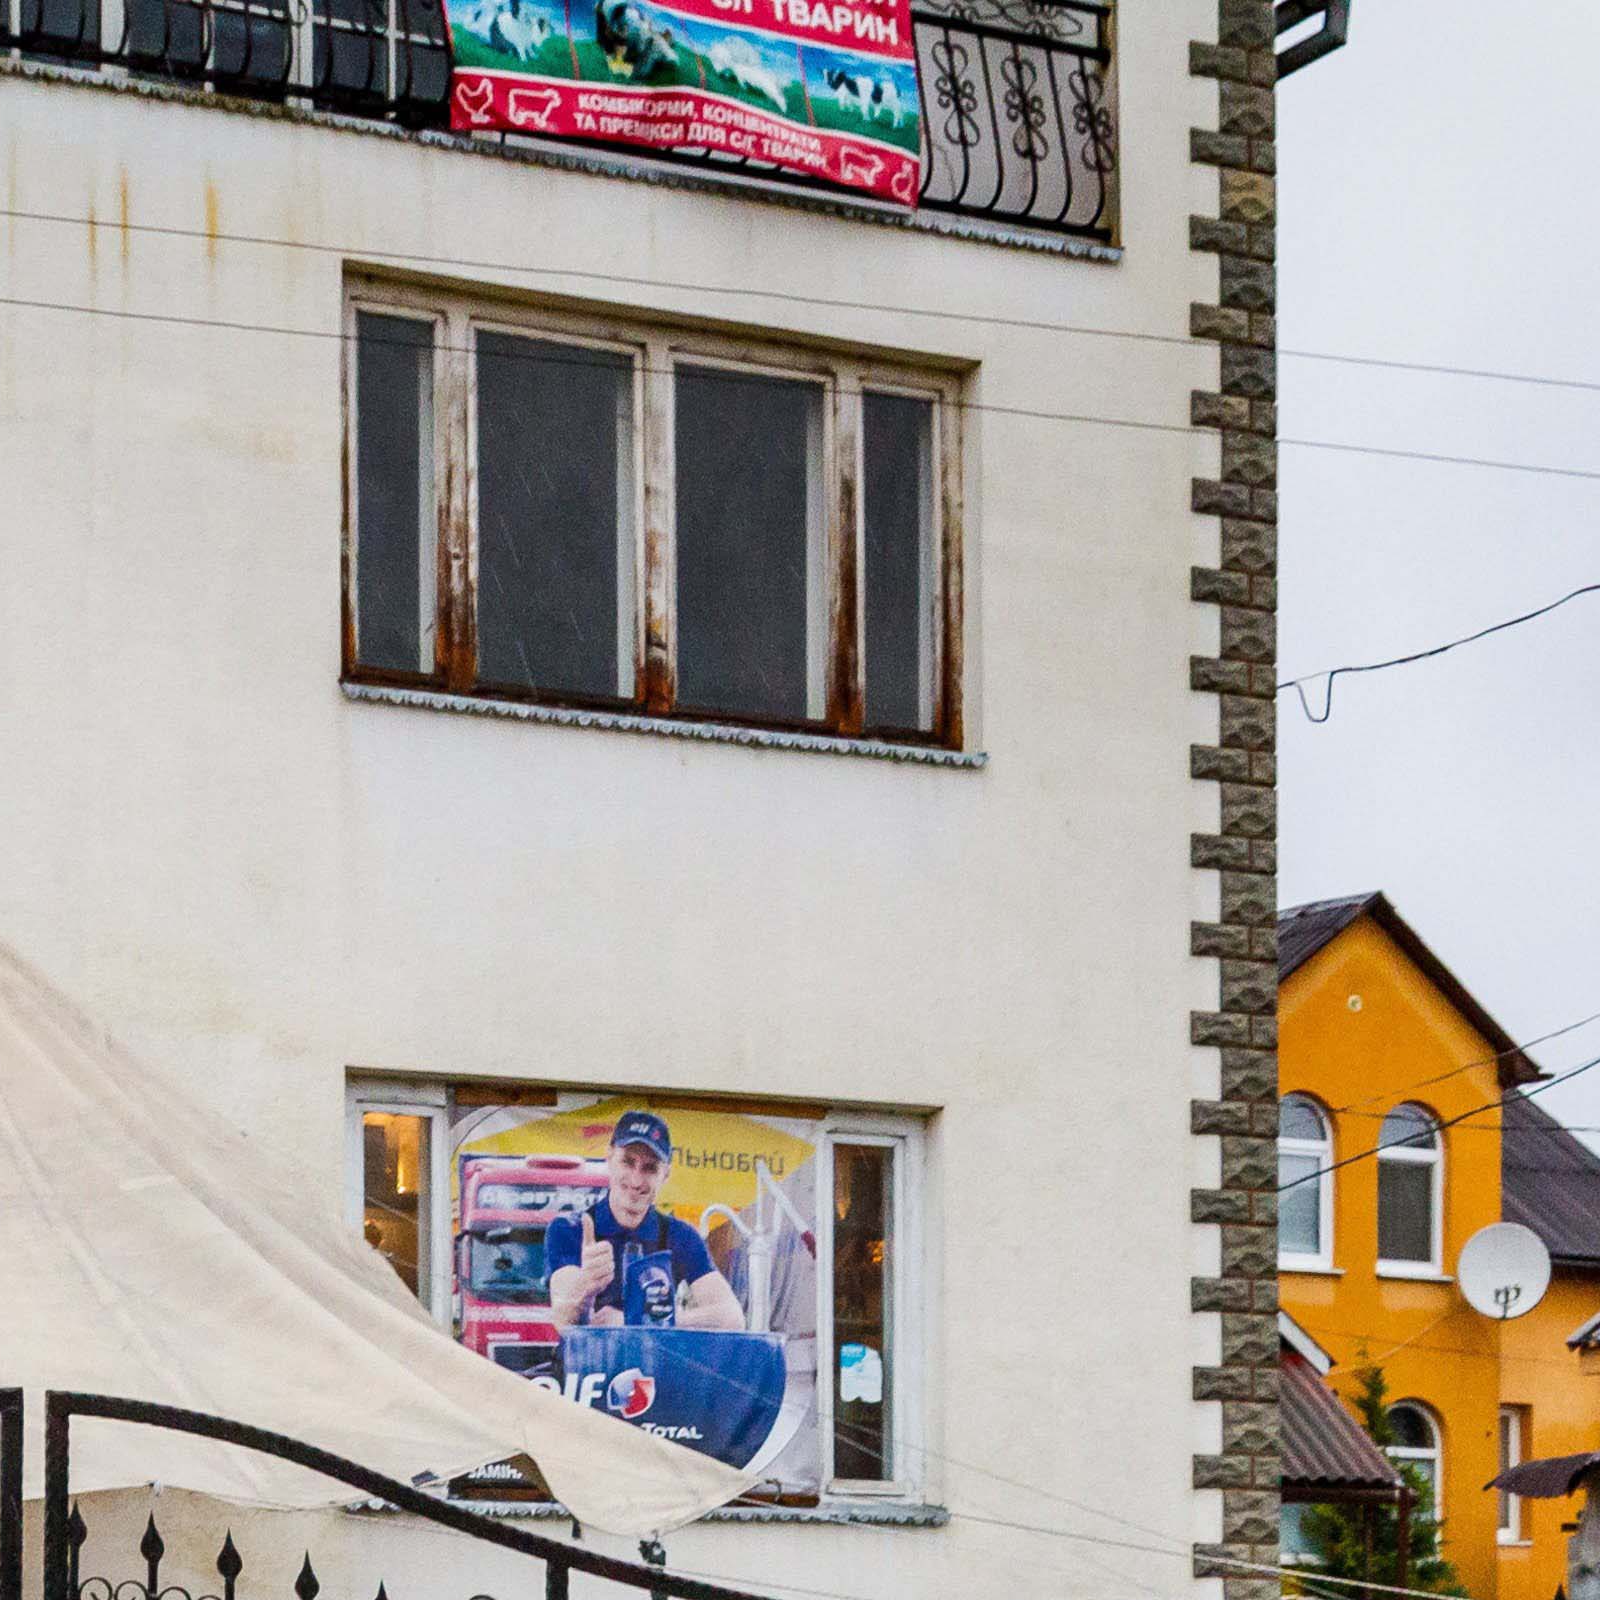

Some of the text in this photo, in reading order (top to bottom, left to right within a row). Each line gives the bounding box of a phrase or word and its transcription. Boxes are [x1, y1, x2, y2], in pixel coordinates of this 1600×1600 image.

[773, 0, 900, 46] ТВАРИН
[573, 112, 596, 130] ТА
[687, 122, 726, 145] ДЛЯ
[640, 1422, 704, 1440] TOTAL
